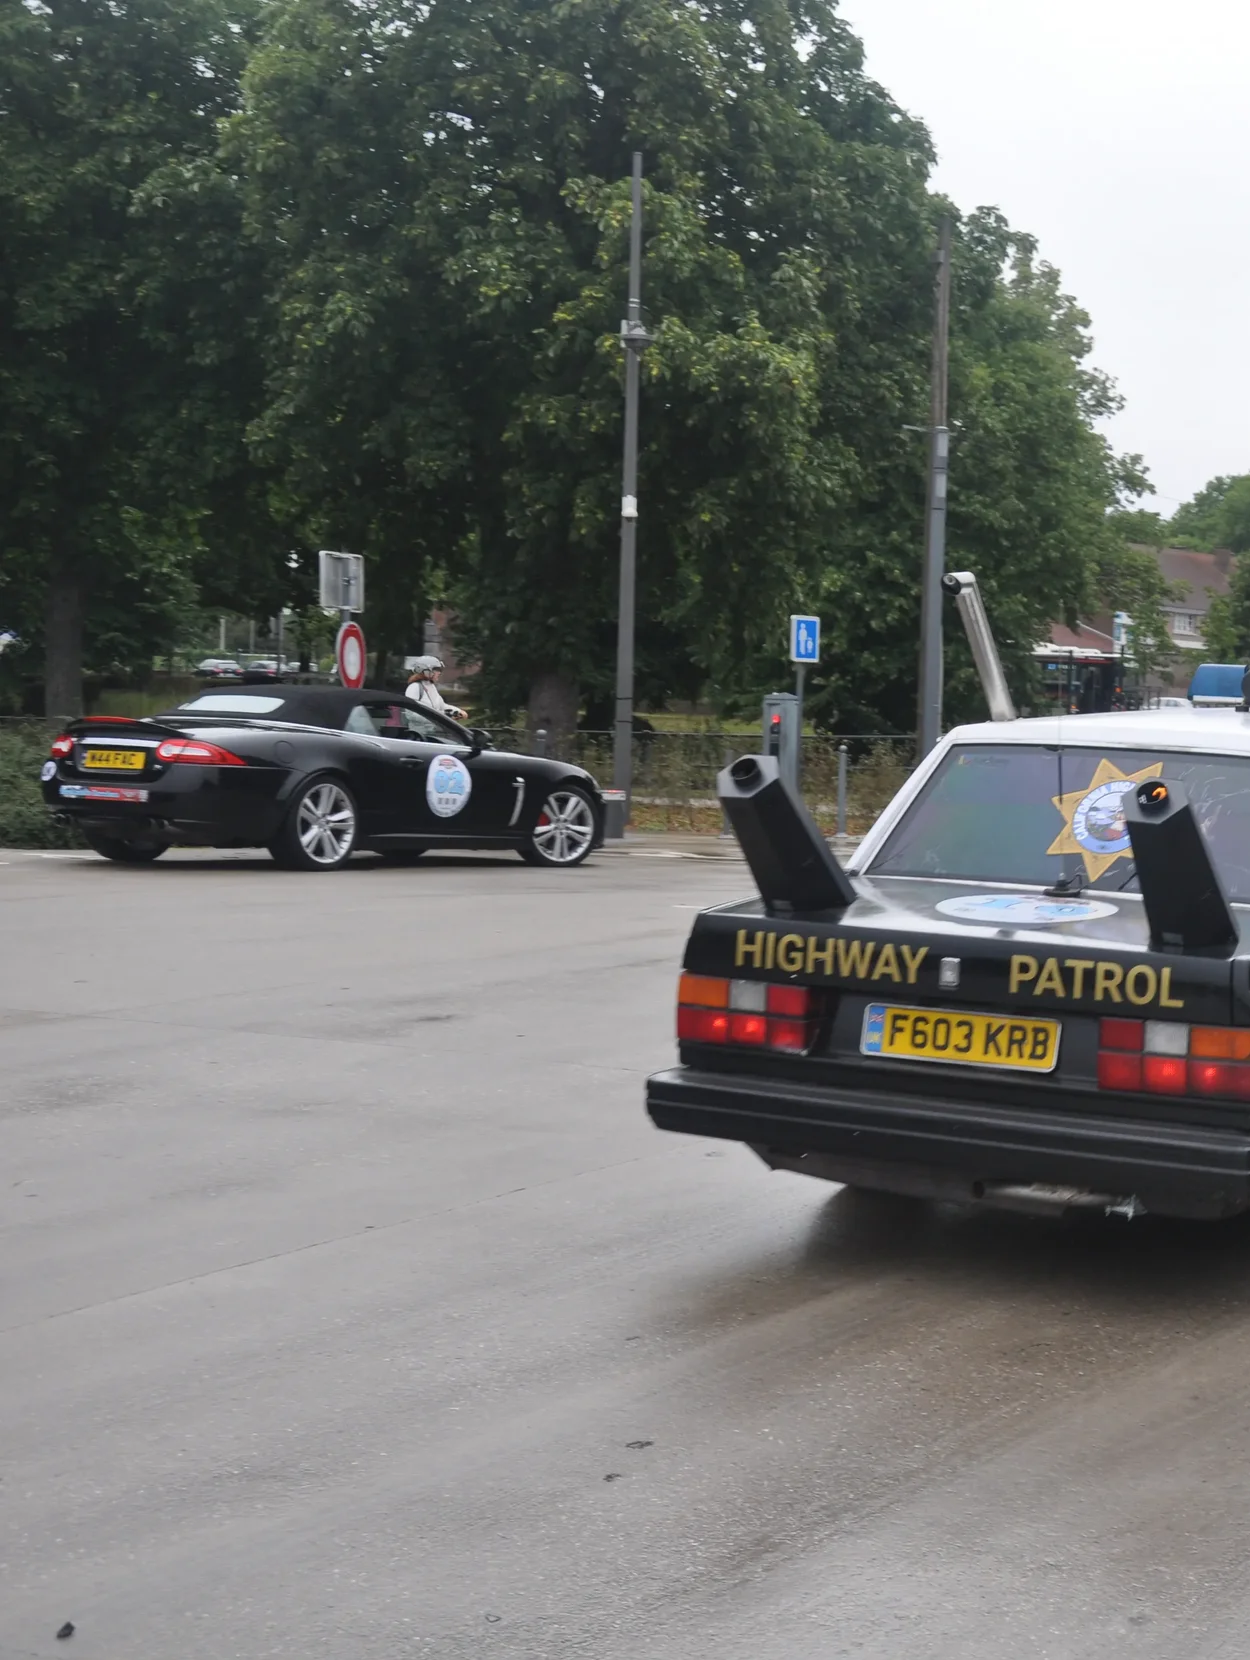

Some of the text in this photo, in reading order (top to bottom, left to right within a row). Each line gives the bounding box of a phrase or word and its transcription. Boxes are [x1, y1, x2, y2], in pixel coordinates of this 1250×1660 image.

[434, 770, 465, 796] 02
[735, 929, 1185, 1009] HIGHWAY PATROL
[888, 1013, 974, 1054] F603
[983, 1022, 1050, 1061] KRB
